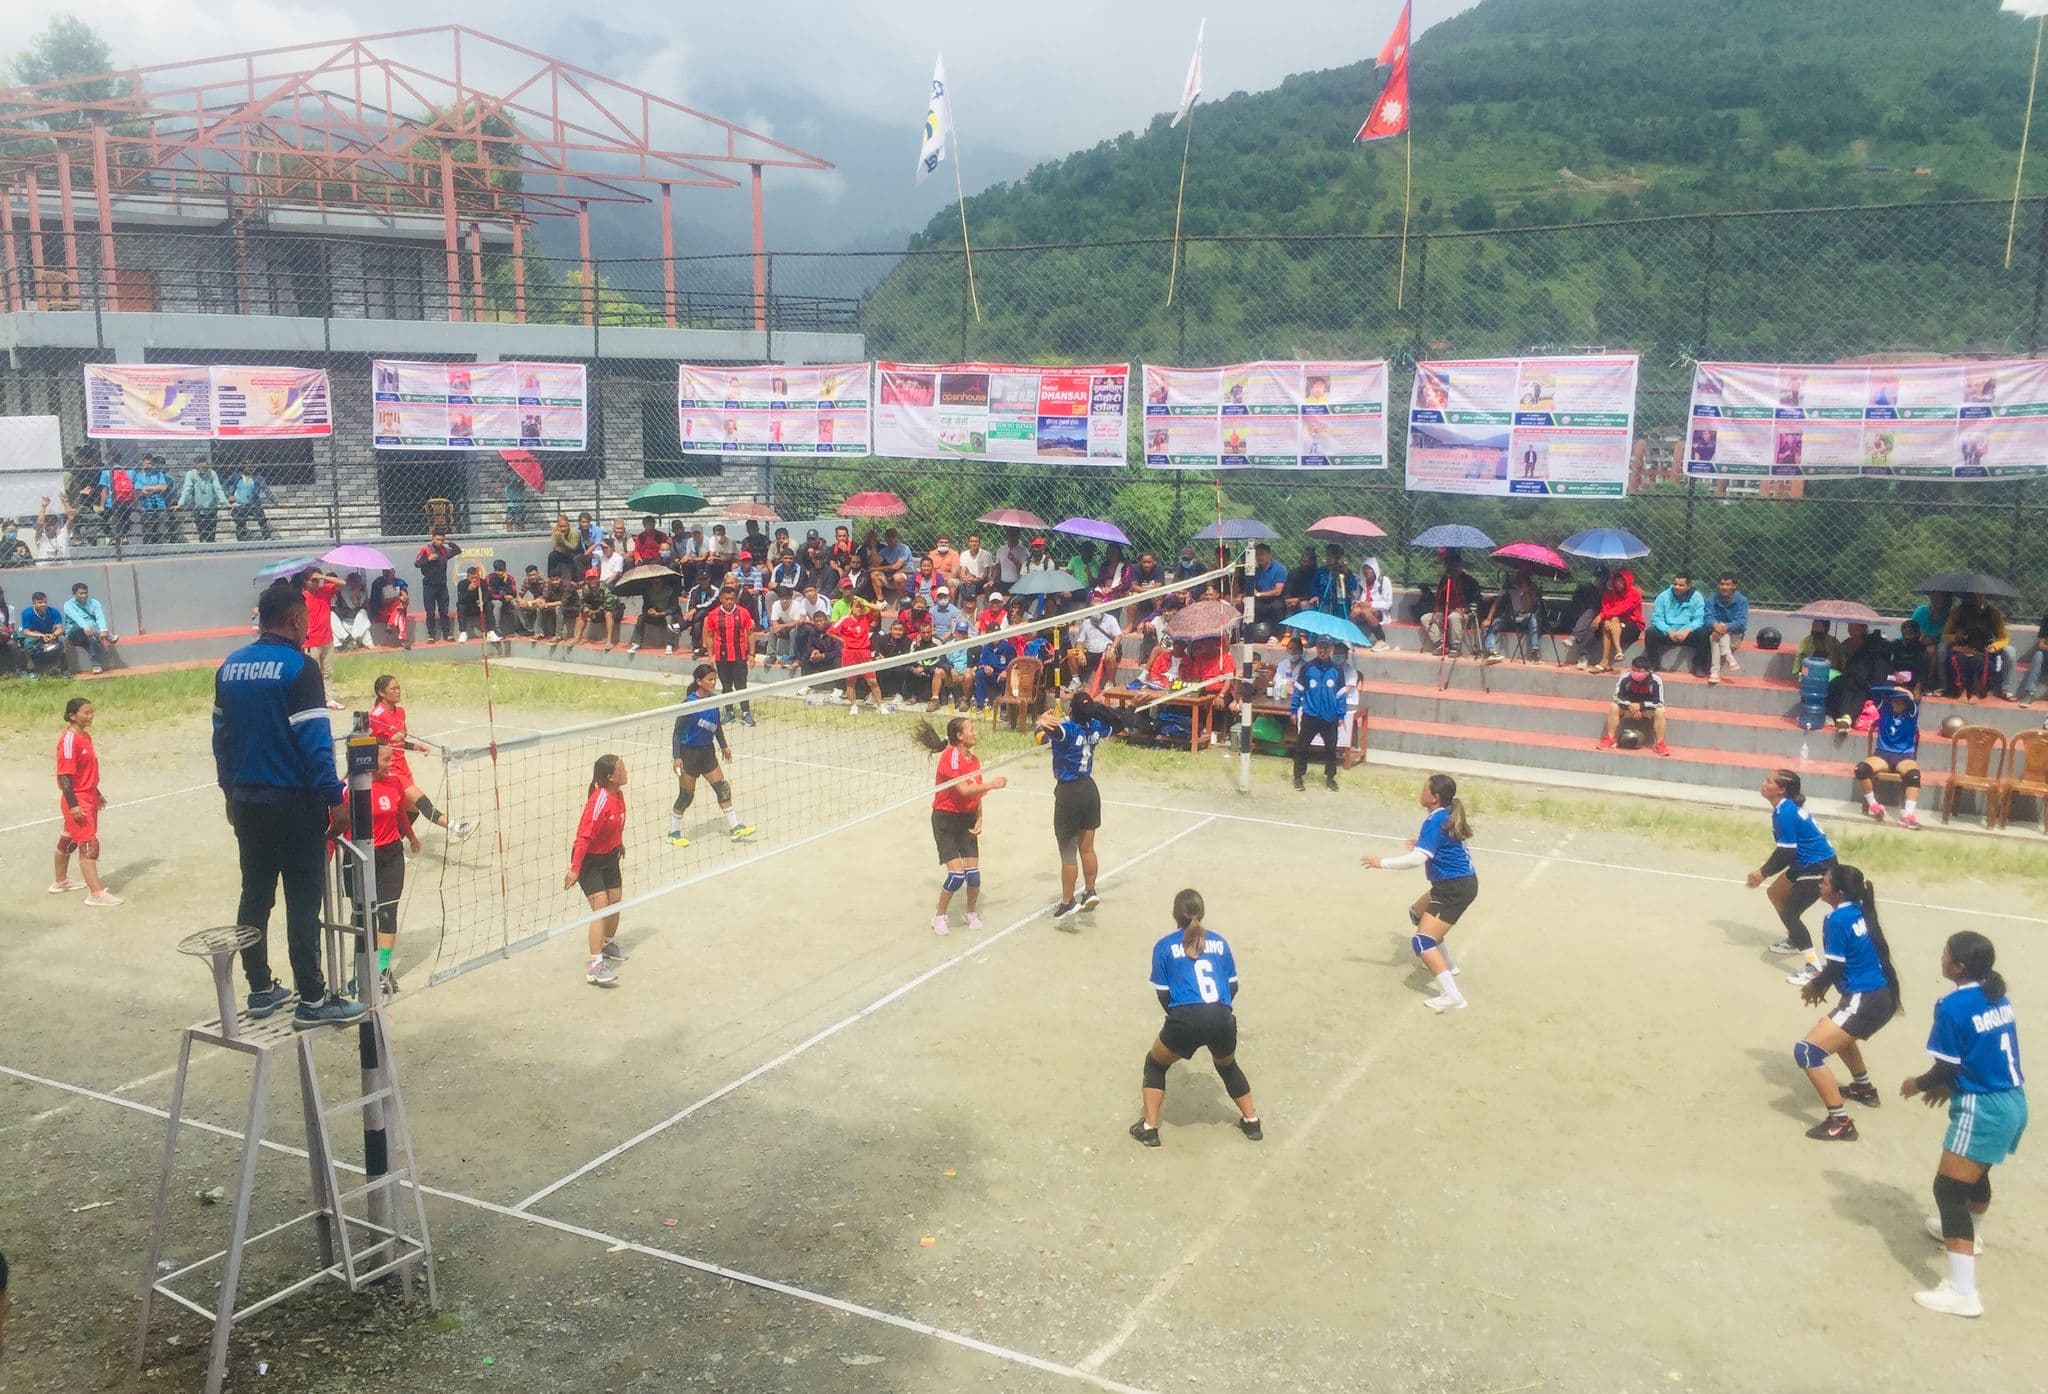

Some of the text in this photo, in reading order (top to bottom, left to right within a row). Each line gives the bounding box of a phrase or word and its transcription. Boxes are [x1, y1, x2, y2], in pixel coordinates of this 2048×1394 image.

[943, 391, 986, 403] openhouse
[1041, 391, 1088, 401] DHANSAR
[222, 661, 284, 682] OFFICIAL
[1194, 959, 1219, 1004] 6
[2000, 1032, 2020, 1087] 1
